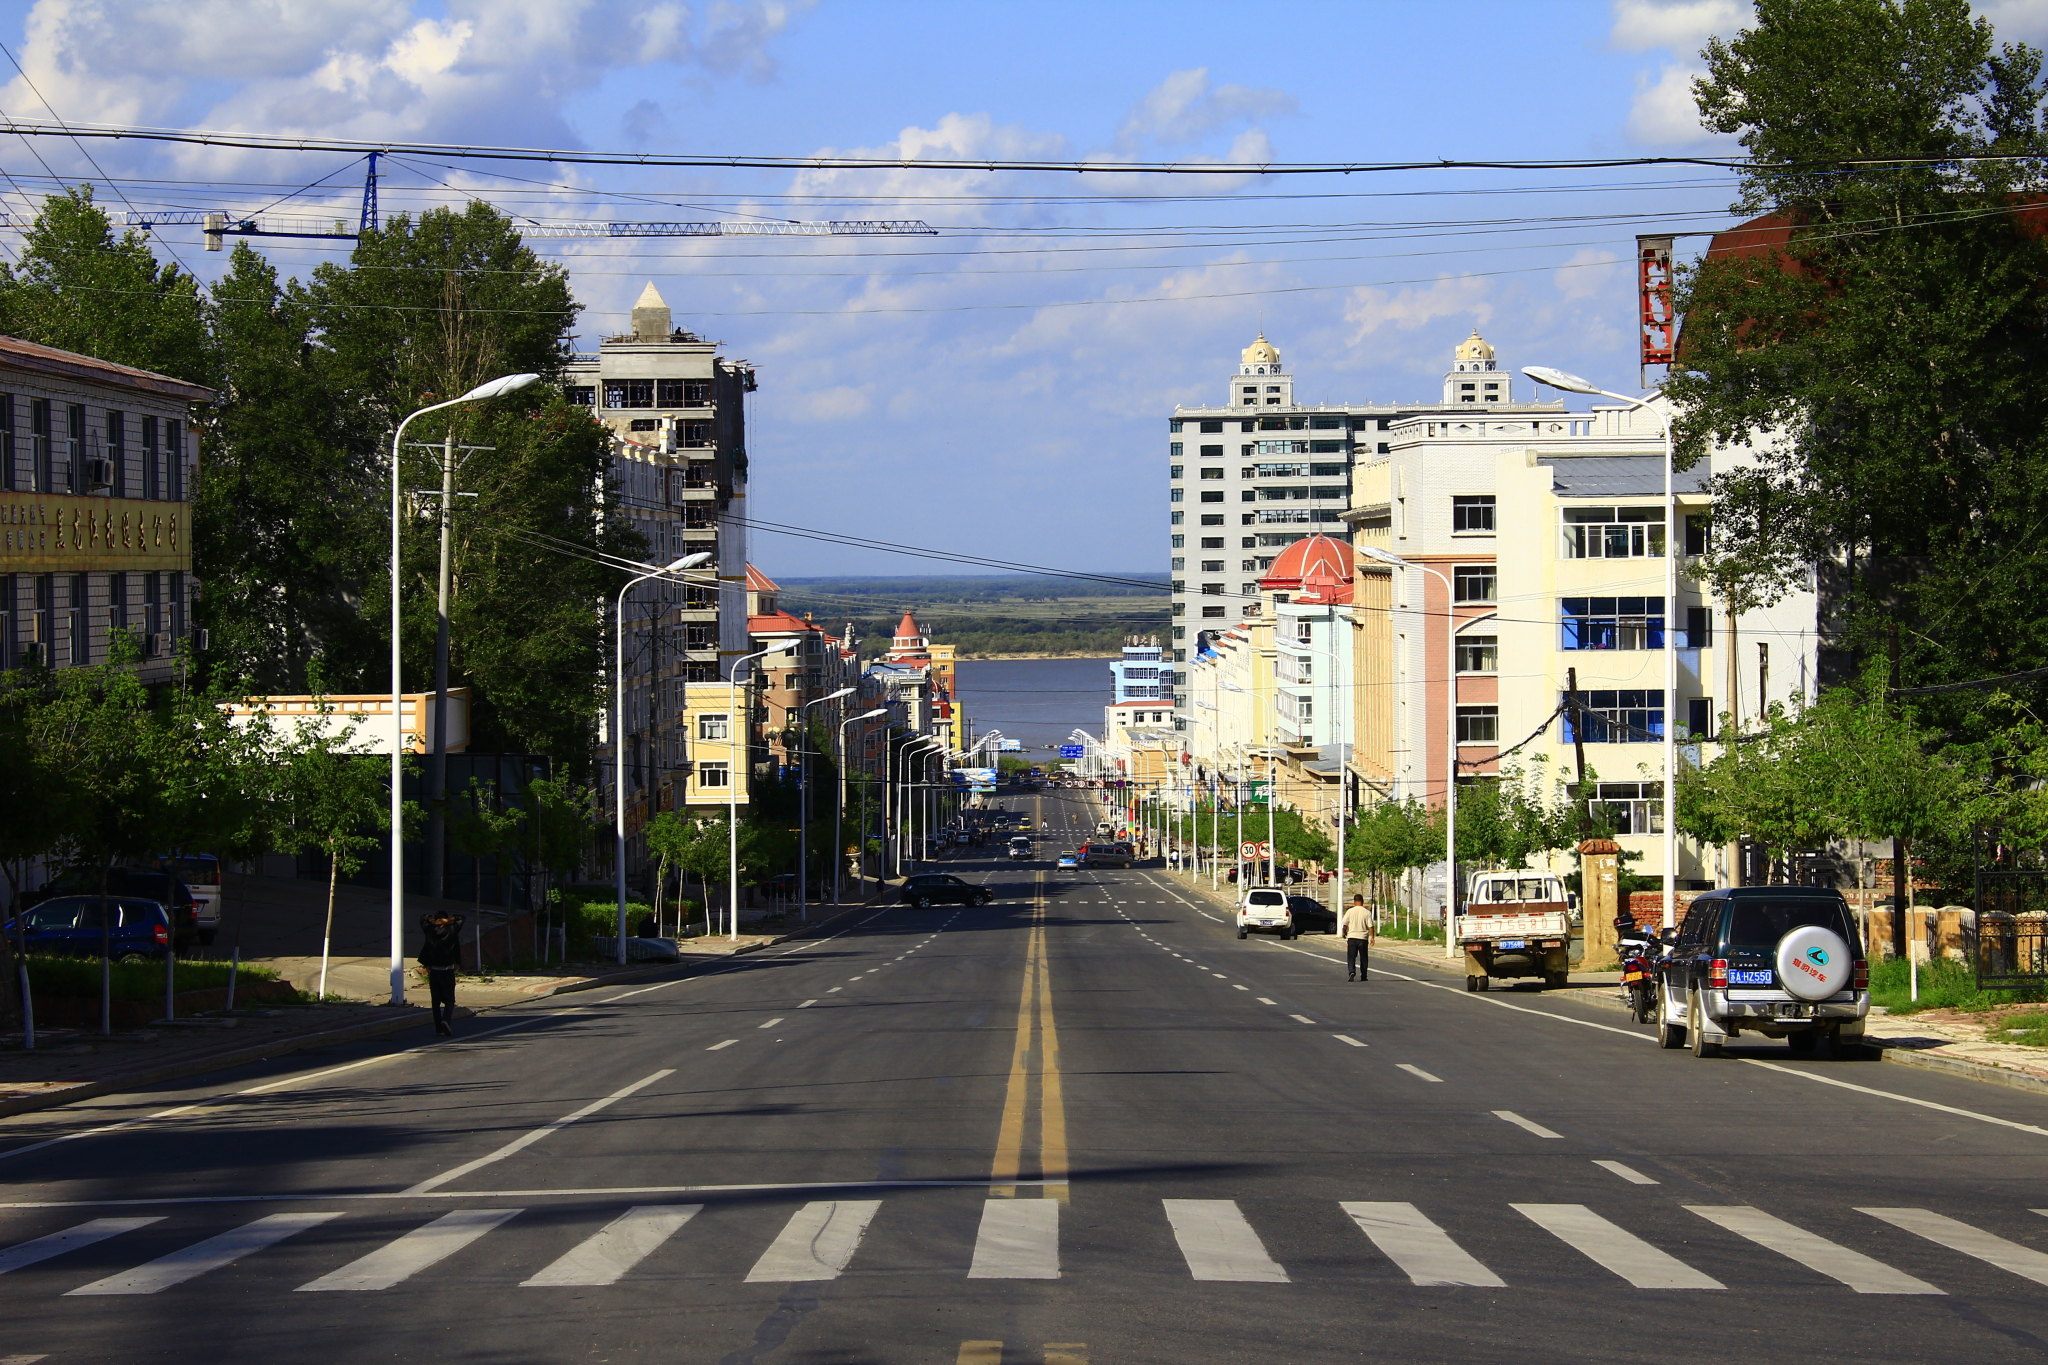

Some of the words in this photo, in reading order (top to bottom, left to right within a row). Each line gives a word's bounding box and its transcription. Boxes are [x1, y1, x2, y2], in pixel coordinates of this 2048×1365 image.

[1244, 846, 1254, 855] 30
[1791, 957, 1828, 983] 猎豹汽车
